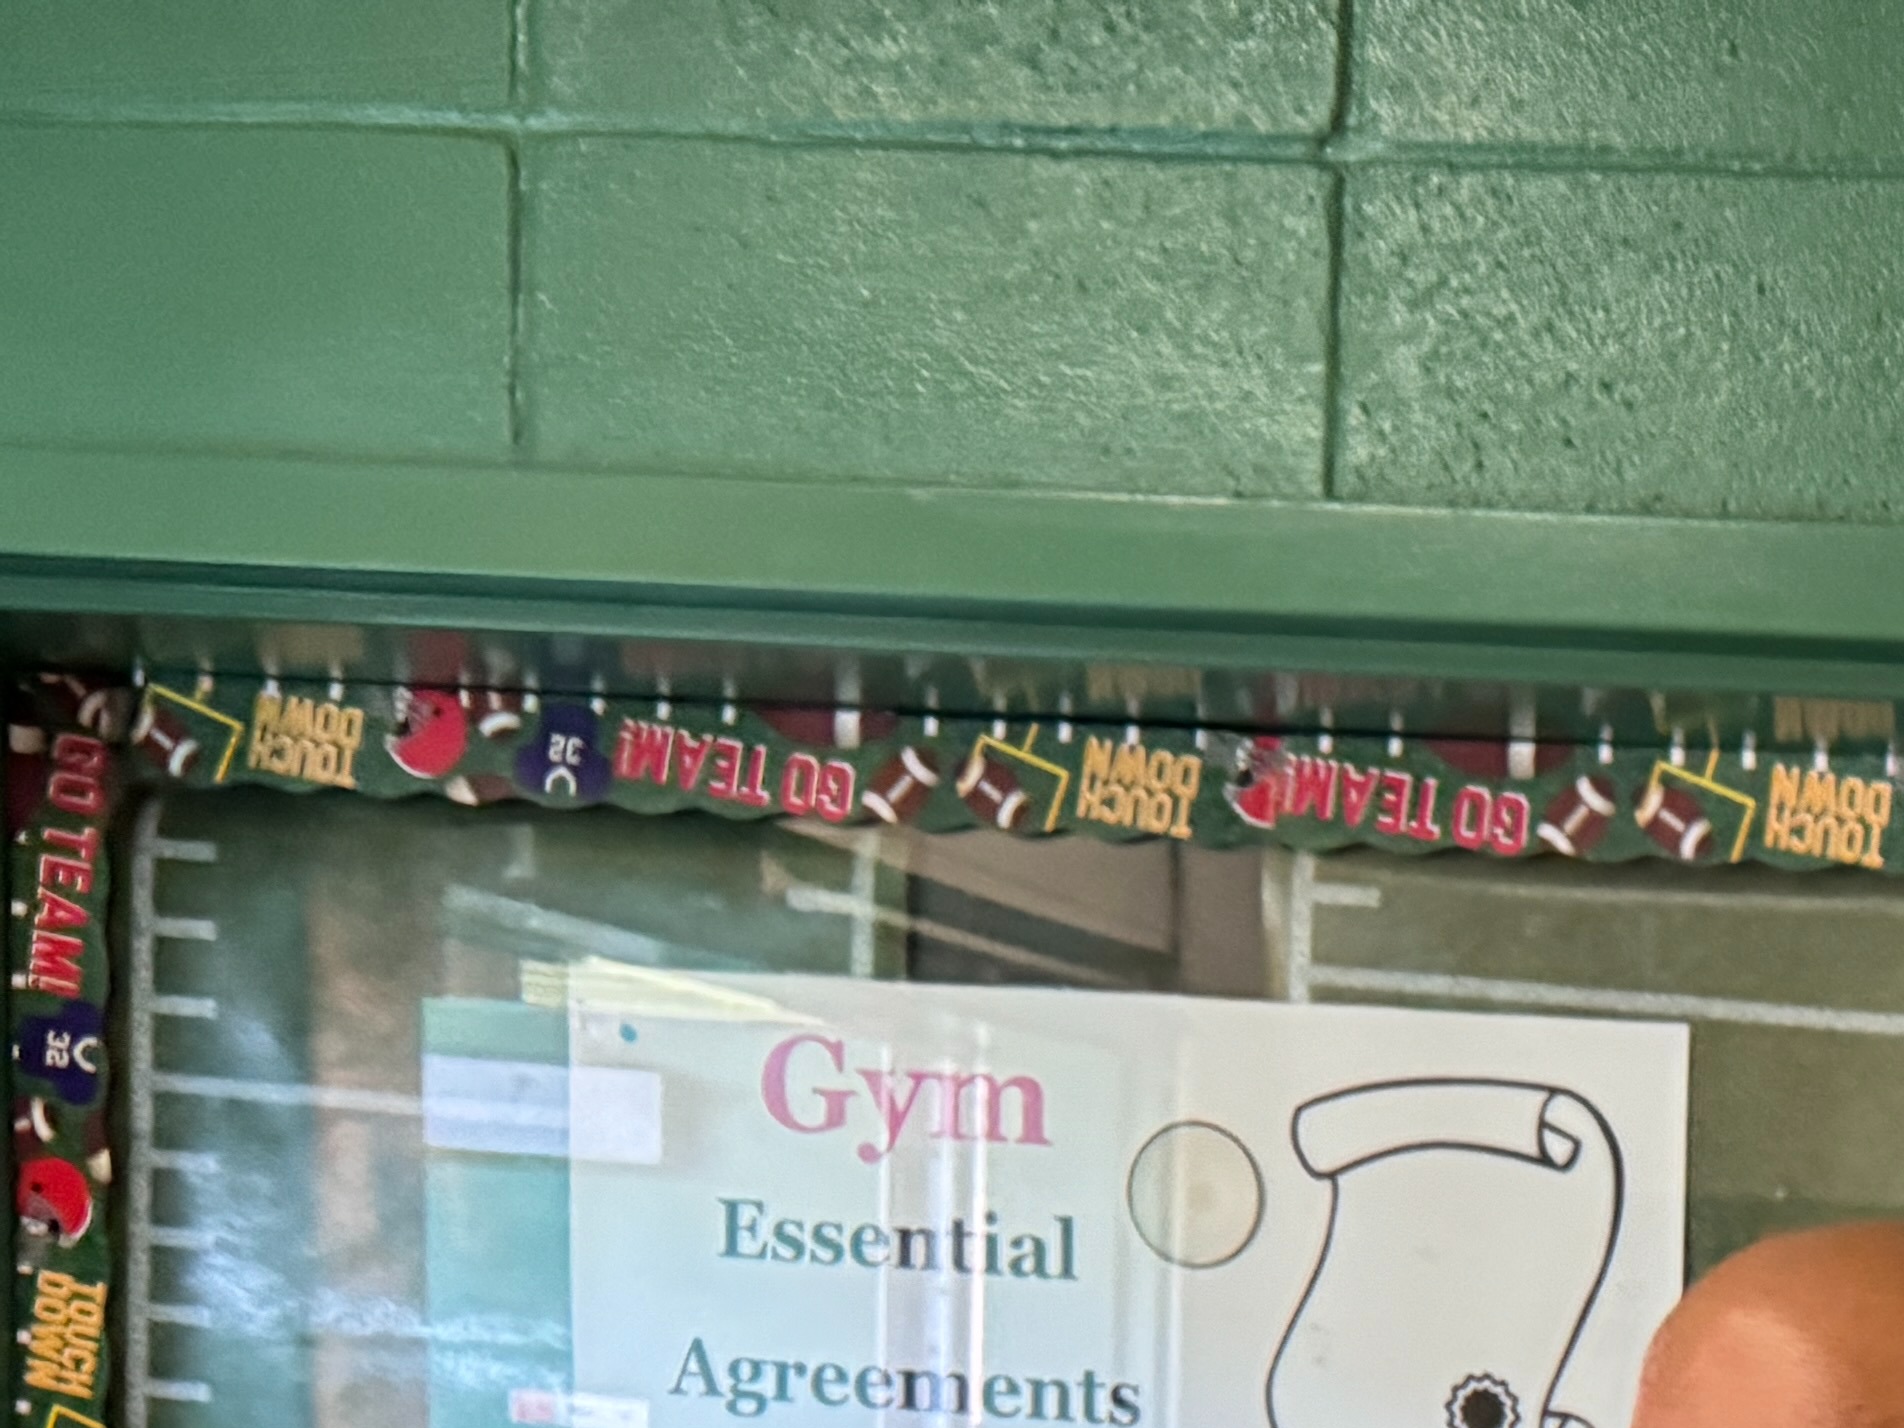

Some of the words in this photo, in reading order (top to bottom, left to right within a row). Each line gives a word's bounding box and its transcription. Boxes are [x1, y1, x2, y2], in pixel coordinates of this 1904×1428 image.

[254, 693, 363, 743] DOWN
[49, 733, 104, 814] GO
[250, 736, 354, 788] TOUCH
[613, 719, 768, 805] TEAM!
[782, 754, 855, 823] GO
[1084, 735, 1200, 800] DOWN
[1771, 763, 1891, 827] DOWN
[1077, 777, 1192, 839] TOUCH
[1451, 785, 1529, 855] GO
[1765, 800, 1884, 869] TOUCH
[28, 827, 98, 999] TEAM!
[761, 1033, 1053, 1163] Gym
[716, 1198, 1079, 1284] Essential
[24, 1269, 74, 1397] DOWN
[62, 1282, 107, 1399] TOUCH
